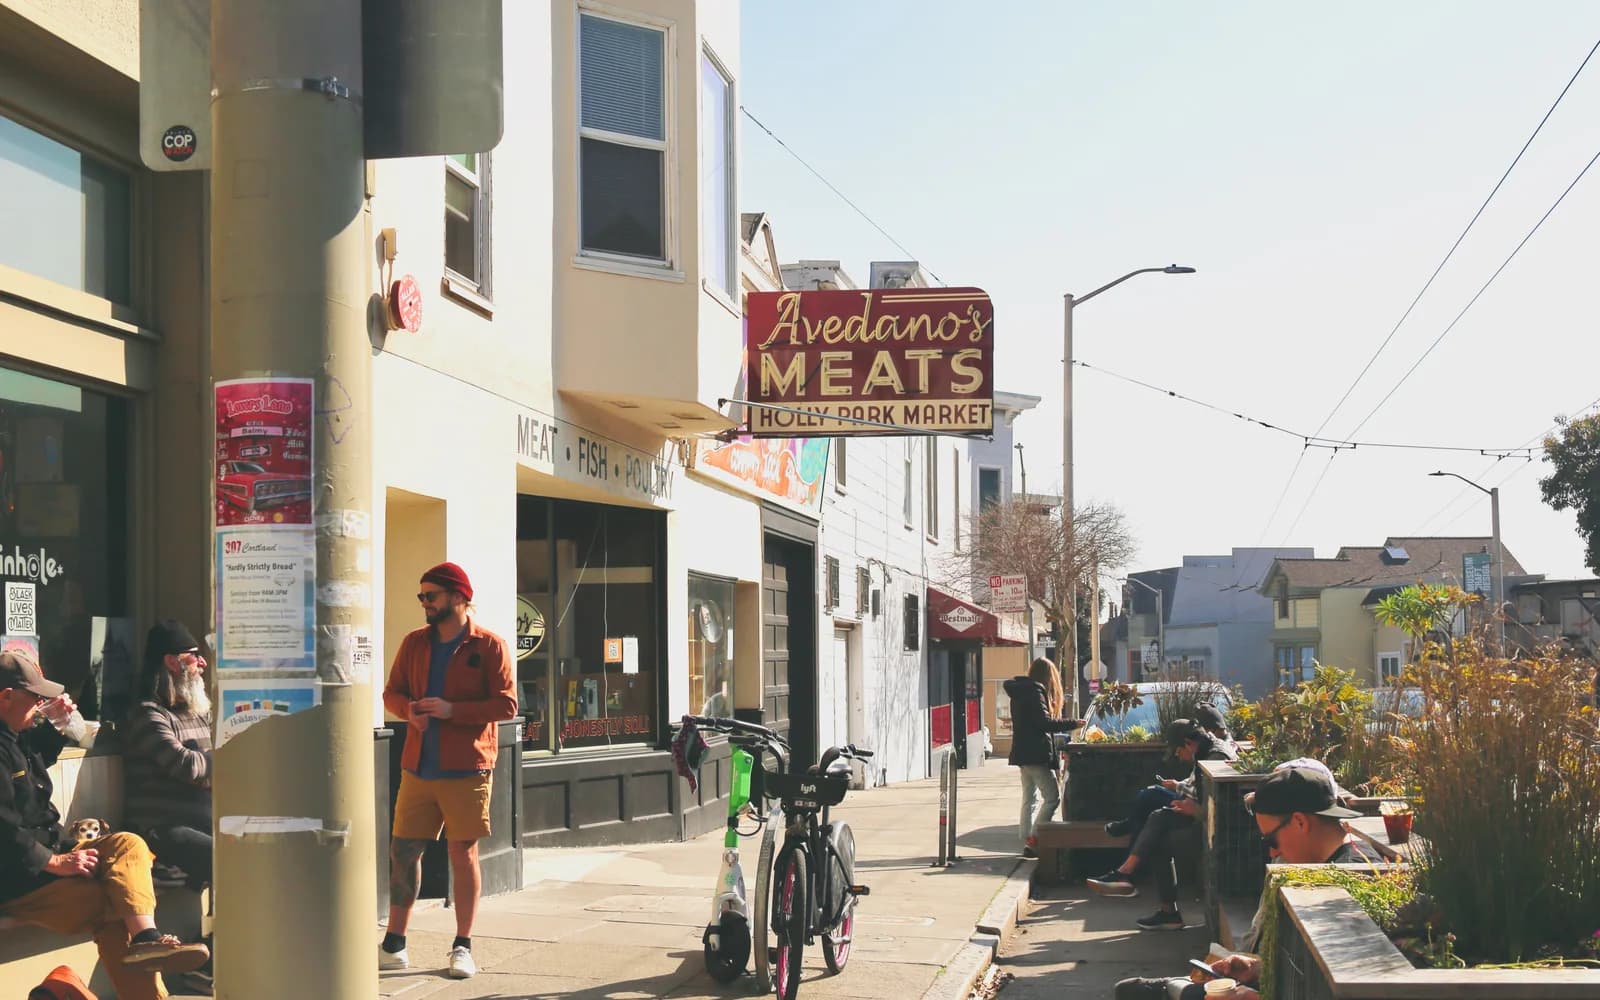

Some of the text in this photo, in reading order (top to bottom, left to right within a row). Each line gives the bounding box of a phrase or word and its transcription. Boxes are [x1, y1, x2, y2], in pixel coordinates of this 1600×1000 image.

[164, 134, 193, 148] COP
[757, 292, 992, 350] Avedano's
[760, 348, 984, 397] MEATS
[760, 404, 990, 427] HOLLY PARK MARKET
[517, 414, 558, 464] MEAT
[578, 437, 608, 480] FISH
[625, 454, 674, 501] POULTRY
[247, 563, 270, 572] Strictly
[991, 576, 1024, 587] NO PARKING
[9, 587, 33, 601] BLACK
[8, 616, 34, 632] MATTER
[517, 637, 534, 648] KET
[562, 717, 621, 738] HONESTLY
[800, 783, 817, 794] lyft
